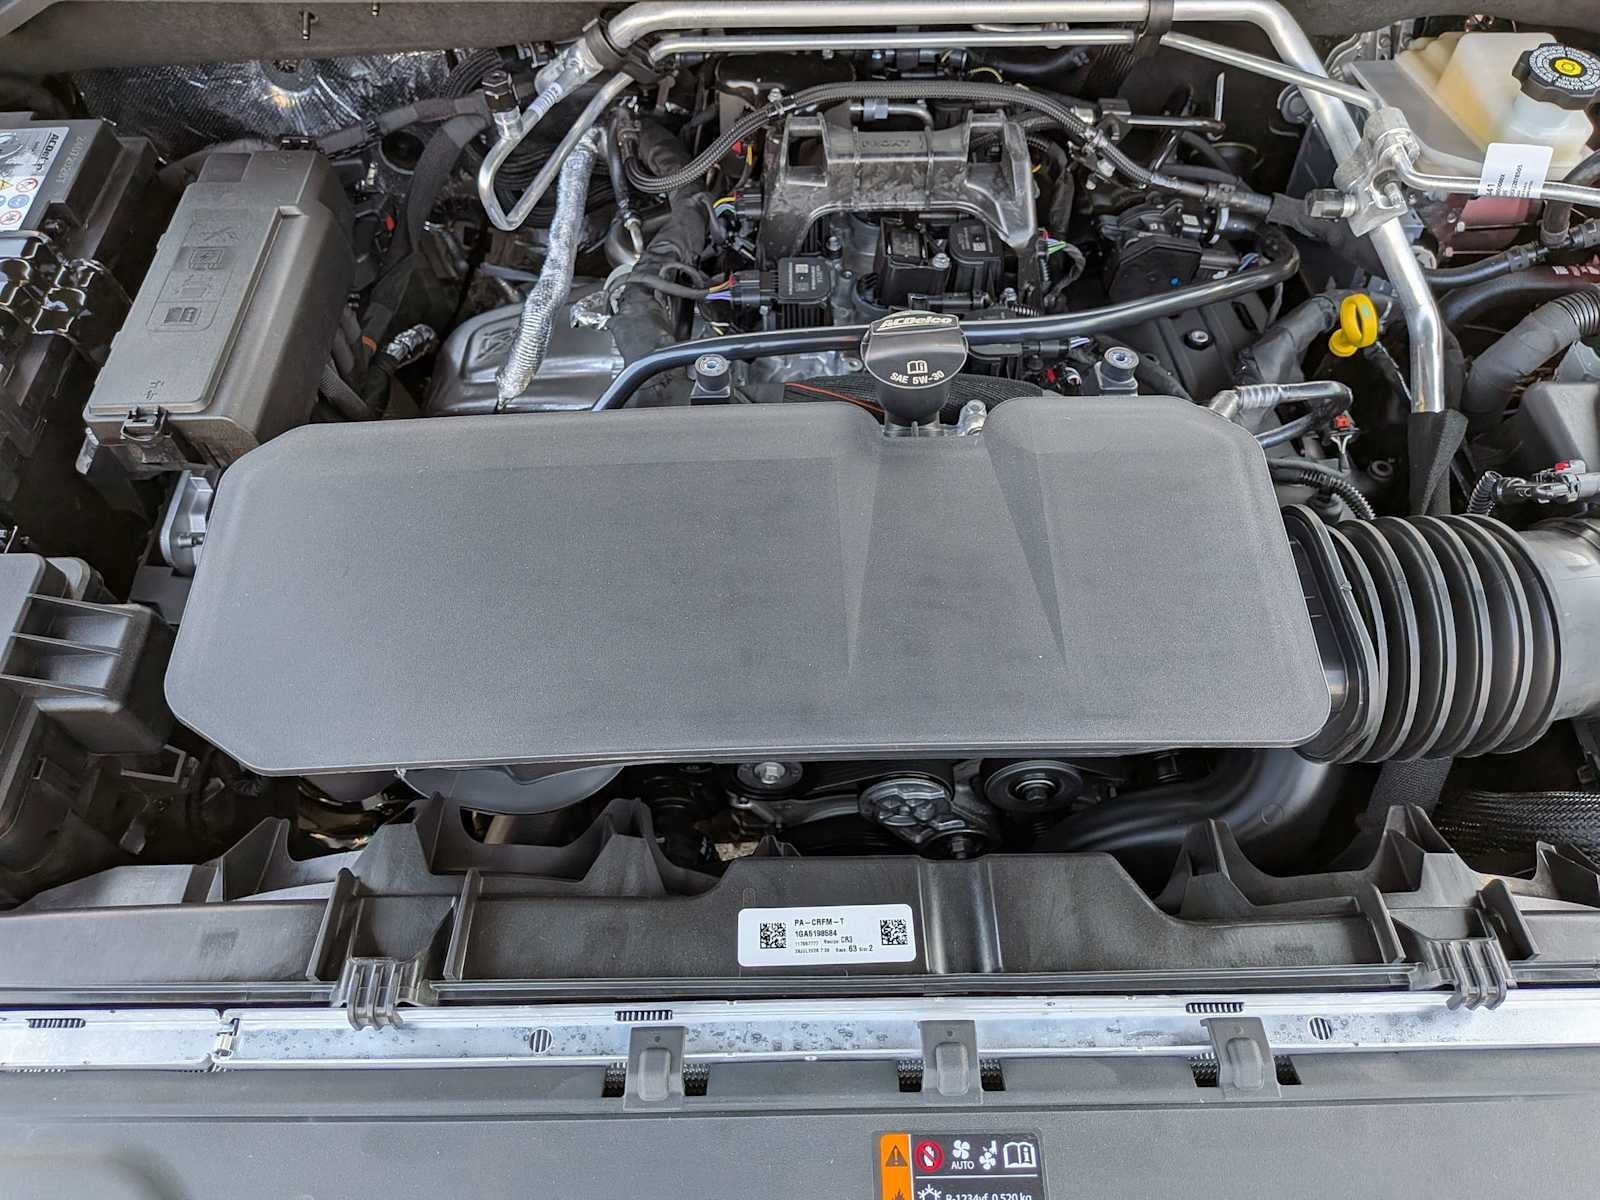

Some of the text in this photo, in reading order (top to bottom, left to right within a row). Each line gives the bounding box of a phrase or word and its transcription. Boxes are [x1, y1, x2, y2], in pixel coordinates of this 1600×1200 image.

[37, 132, 60, 171] ACDelo
[880, 316, 952, 328] ACDelco
[889, 370, 944, 384] SAE 5W-30
[951, 1160, 975, 1170] AUTO
